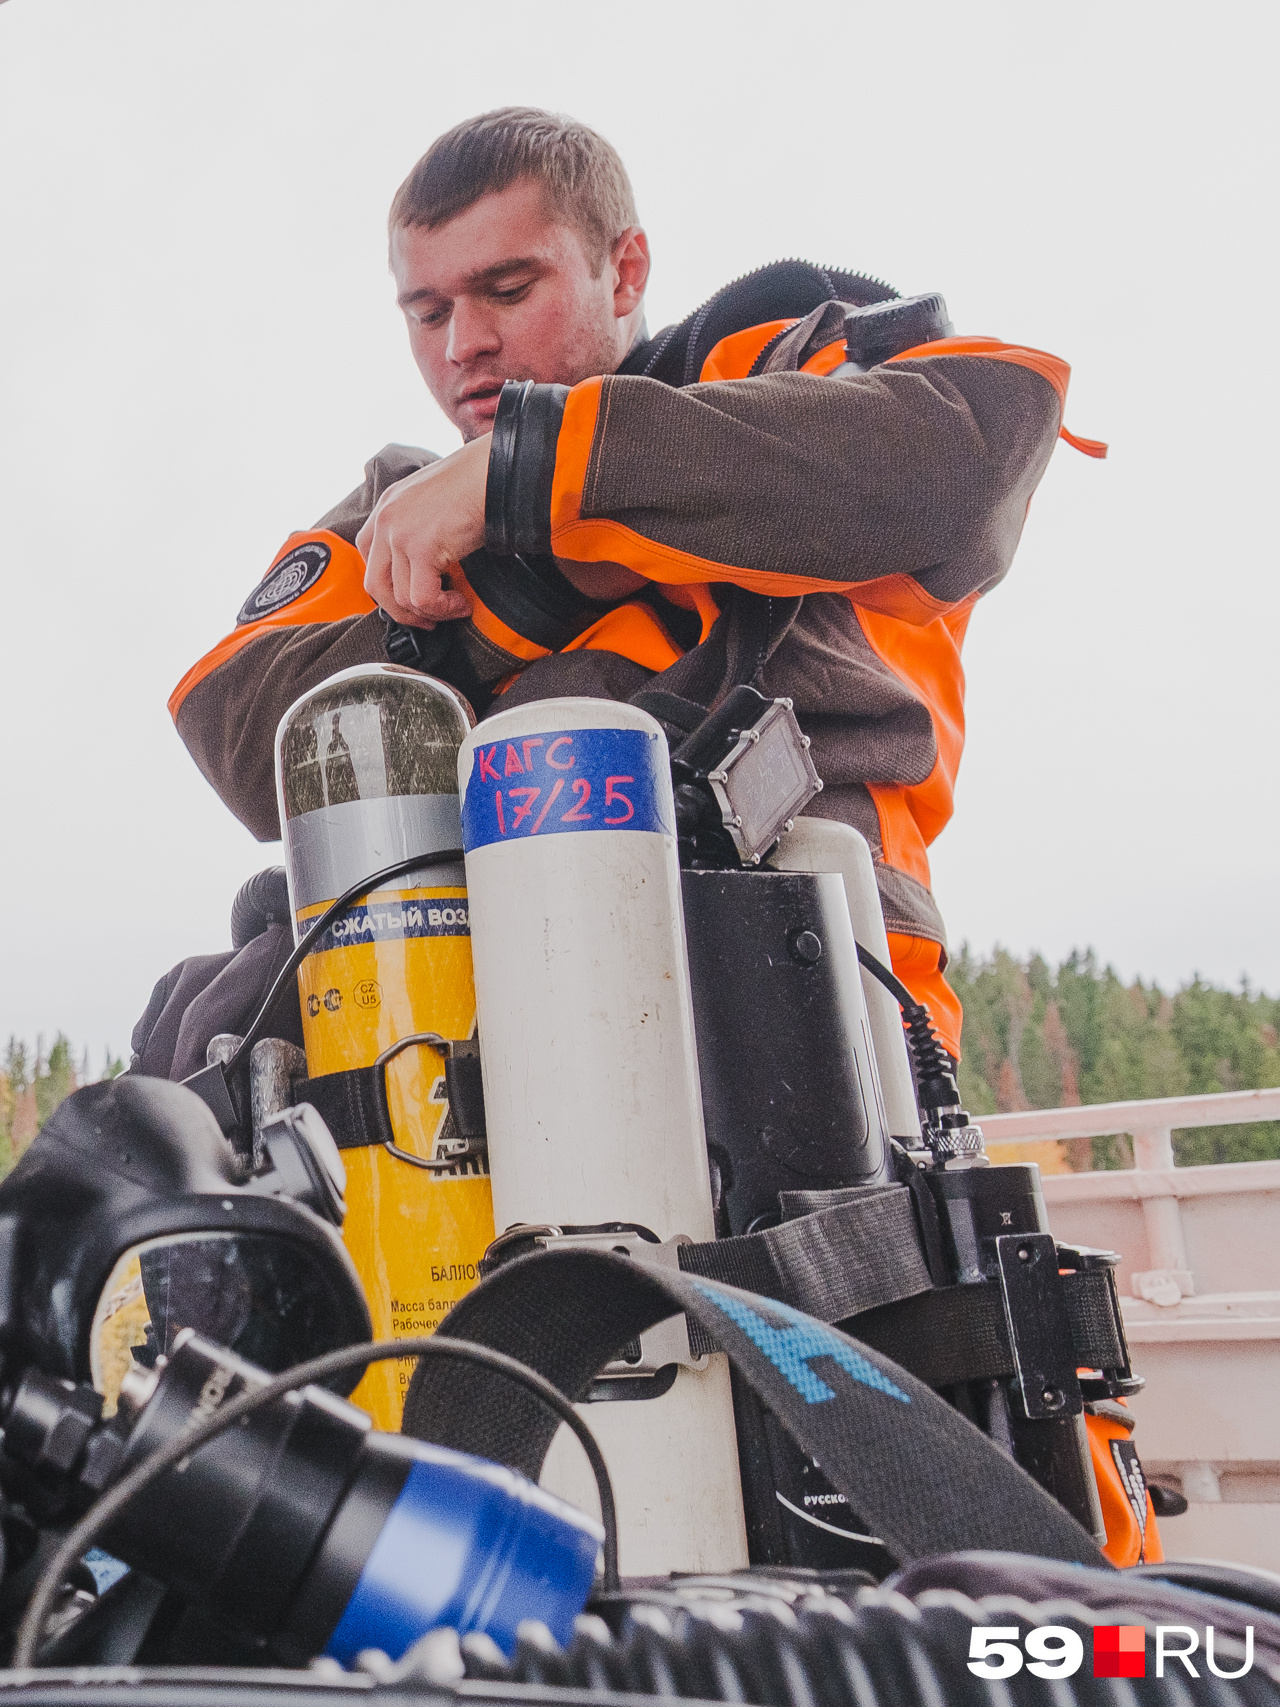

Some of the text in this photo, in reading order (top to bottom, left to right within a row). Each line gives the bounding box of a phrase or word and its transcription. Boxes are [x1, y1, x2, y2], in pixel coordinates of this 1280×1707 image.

[479, 736, 575, 783] КАГС
[495, 775, 635, 835] 17/25
[331, 906, 470, 938] СЖАТЫЙ ВОЗ
[431, 1263, 479, 1282] БАЛЛО
[391, 1300, 425, 1313] Масса
[392, 1318, 438, 1331] Рабочее
[804, 1494, 848, 1506] РУССКО
